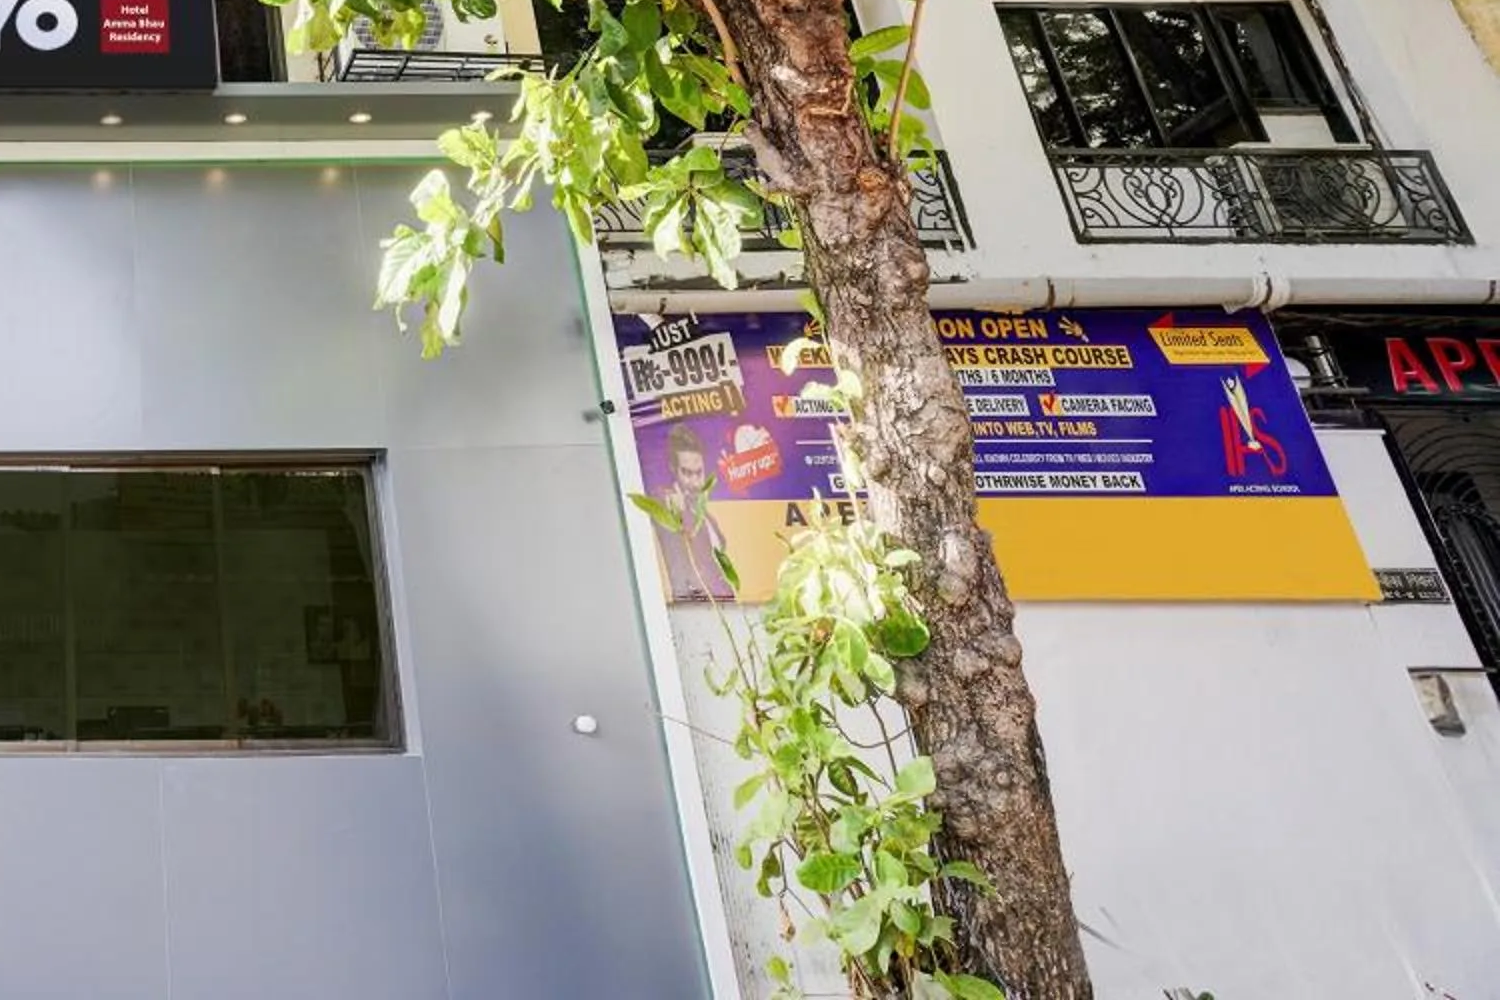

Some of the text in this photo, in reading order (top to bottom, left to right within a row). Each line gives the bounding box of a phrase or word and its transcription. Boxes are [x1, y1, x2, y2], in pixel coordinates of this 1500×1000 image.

[121, 5, 149, 15] Hotel
[109, 32, 162, 43] Residency
[981, 318, 1049, 339] OPEN
[1160, 330, 1245, 347] Limited Seats
[983, 347, 1049, 365] CRASH
[1052, 347, 1130, 365] COURSE
[1000, 369, 1052, 384] MONTHS
[975, 398, 1026, 412] DELIVERY
[1061, 398, 1110, 412] CAMERA
[1111, 398, 1153, 413] FACING
[1059, 421, 1097, 436] FILMS
[1050, 475, 1098, 488] MONEY
[1101, 474, 1141, 488] BACK
